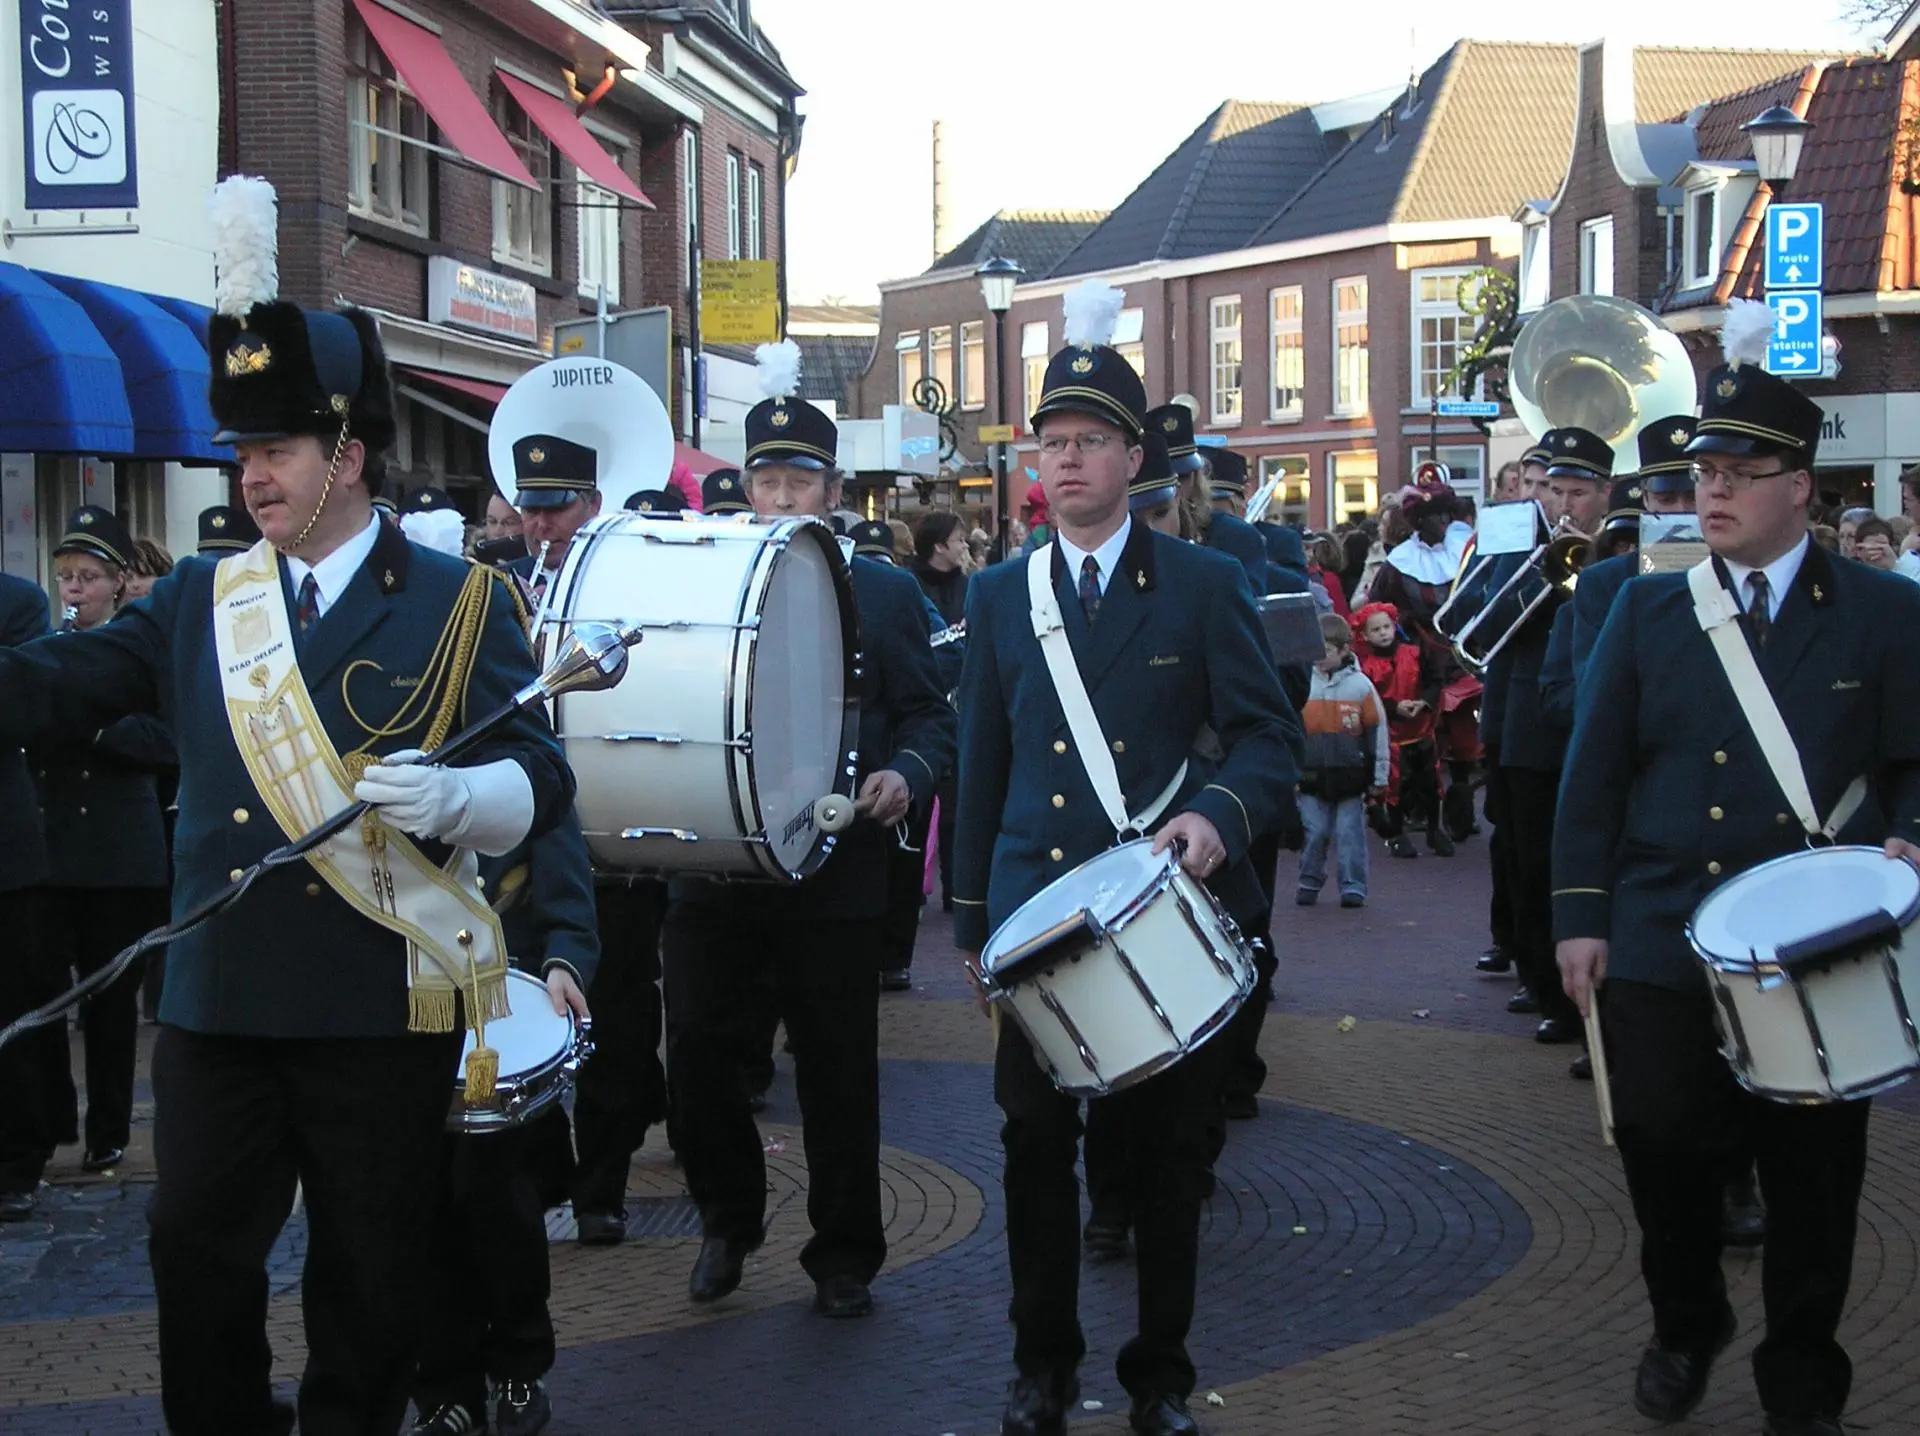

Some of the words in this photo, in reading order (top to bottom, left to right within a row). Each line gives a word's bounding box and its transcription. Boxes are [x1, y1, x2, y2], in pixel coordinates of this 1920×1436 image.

[1778, 210, 1810, 253] P
[1778, 254, 1810, 263] route
[1778, 297, 1809, 339] P
[1773, 340, 1814, 350] station
[552, 366, 614, 388] JUPITER
[228, 660, 252, 675] STAD
[253, 641, 284, 662] DELDEN
